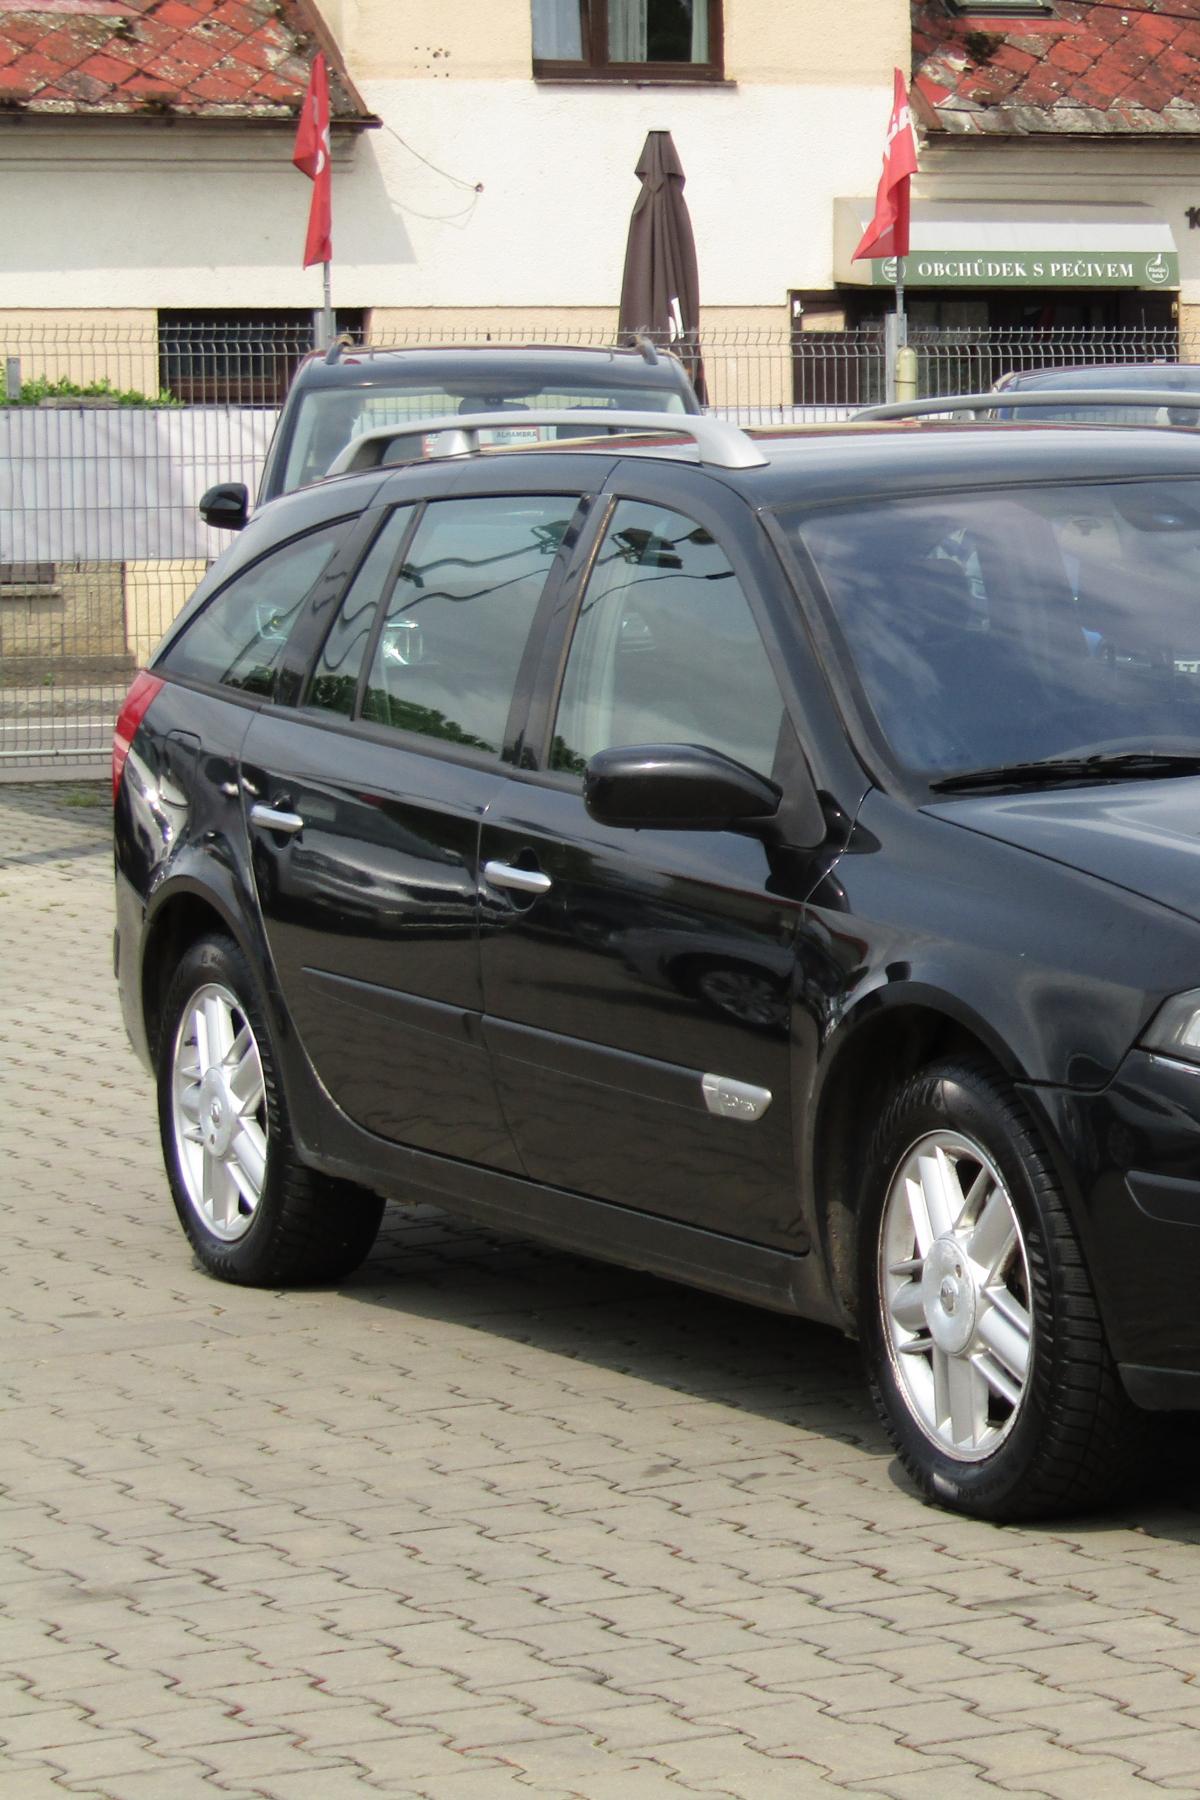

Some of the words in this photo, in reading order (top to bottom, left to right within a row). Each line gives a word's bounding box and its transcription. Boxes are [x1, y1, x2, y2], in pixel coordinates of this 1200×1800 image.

[918, 258, 1027, 277] OBCHŮDEK
[1033, 263, 1044, 277] S
[1050, 260, 1134, 278] PEČIVEM
[496, 430, 537, 438] ALHAMBRA
